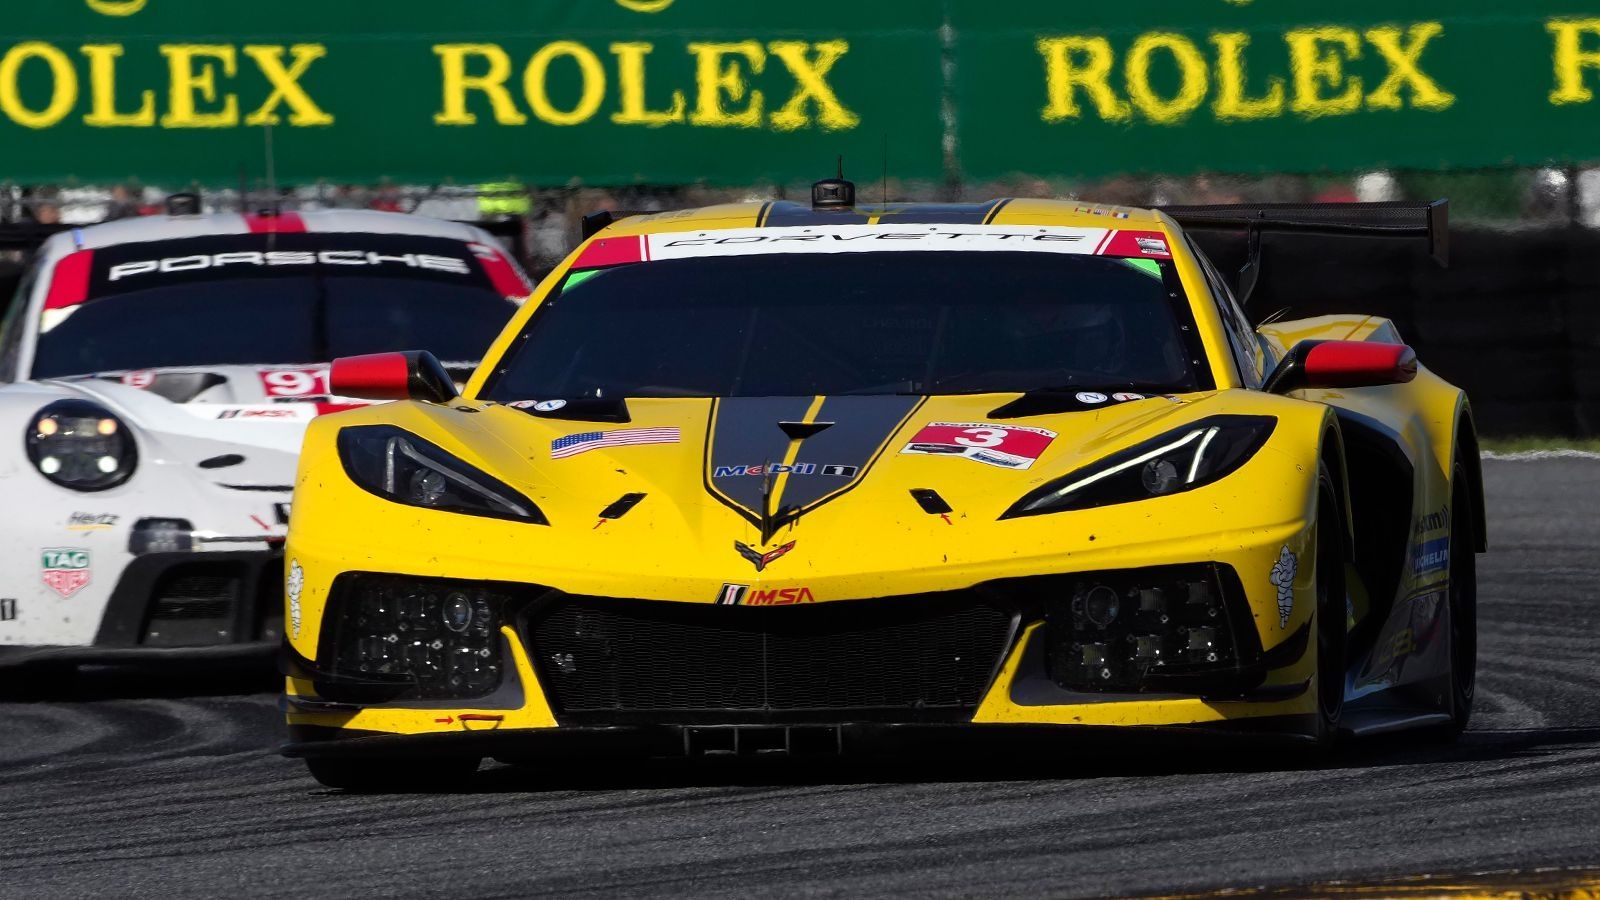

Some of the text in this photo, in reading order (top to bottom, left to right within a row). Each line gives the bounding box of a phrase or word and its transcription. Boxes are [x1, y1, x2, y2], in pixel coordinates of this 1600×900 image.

[1038, 23, 1454, 121] ROLEX
[433, 41, 858, 129] ROLEX
[663, 229, 1087, 248] CORVETTE
[108, 250, 470, 281] PORSCHE
[954, 427, 1009, 448] 3
[713, 463, 817, 477] Mobil
[44, 551, 89, 569] TAG
[746, 587, 816, 605] IMSA
